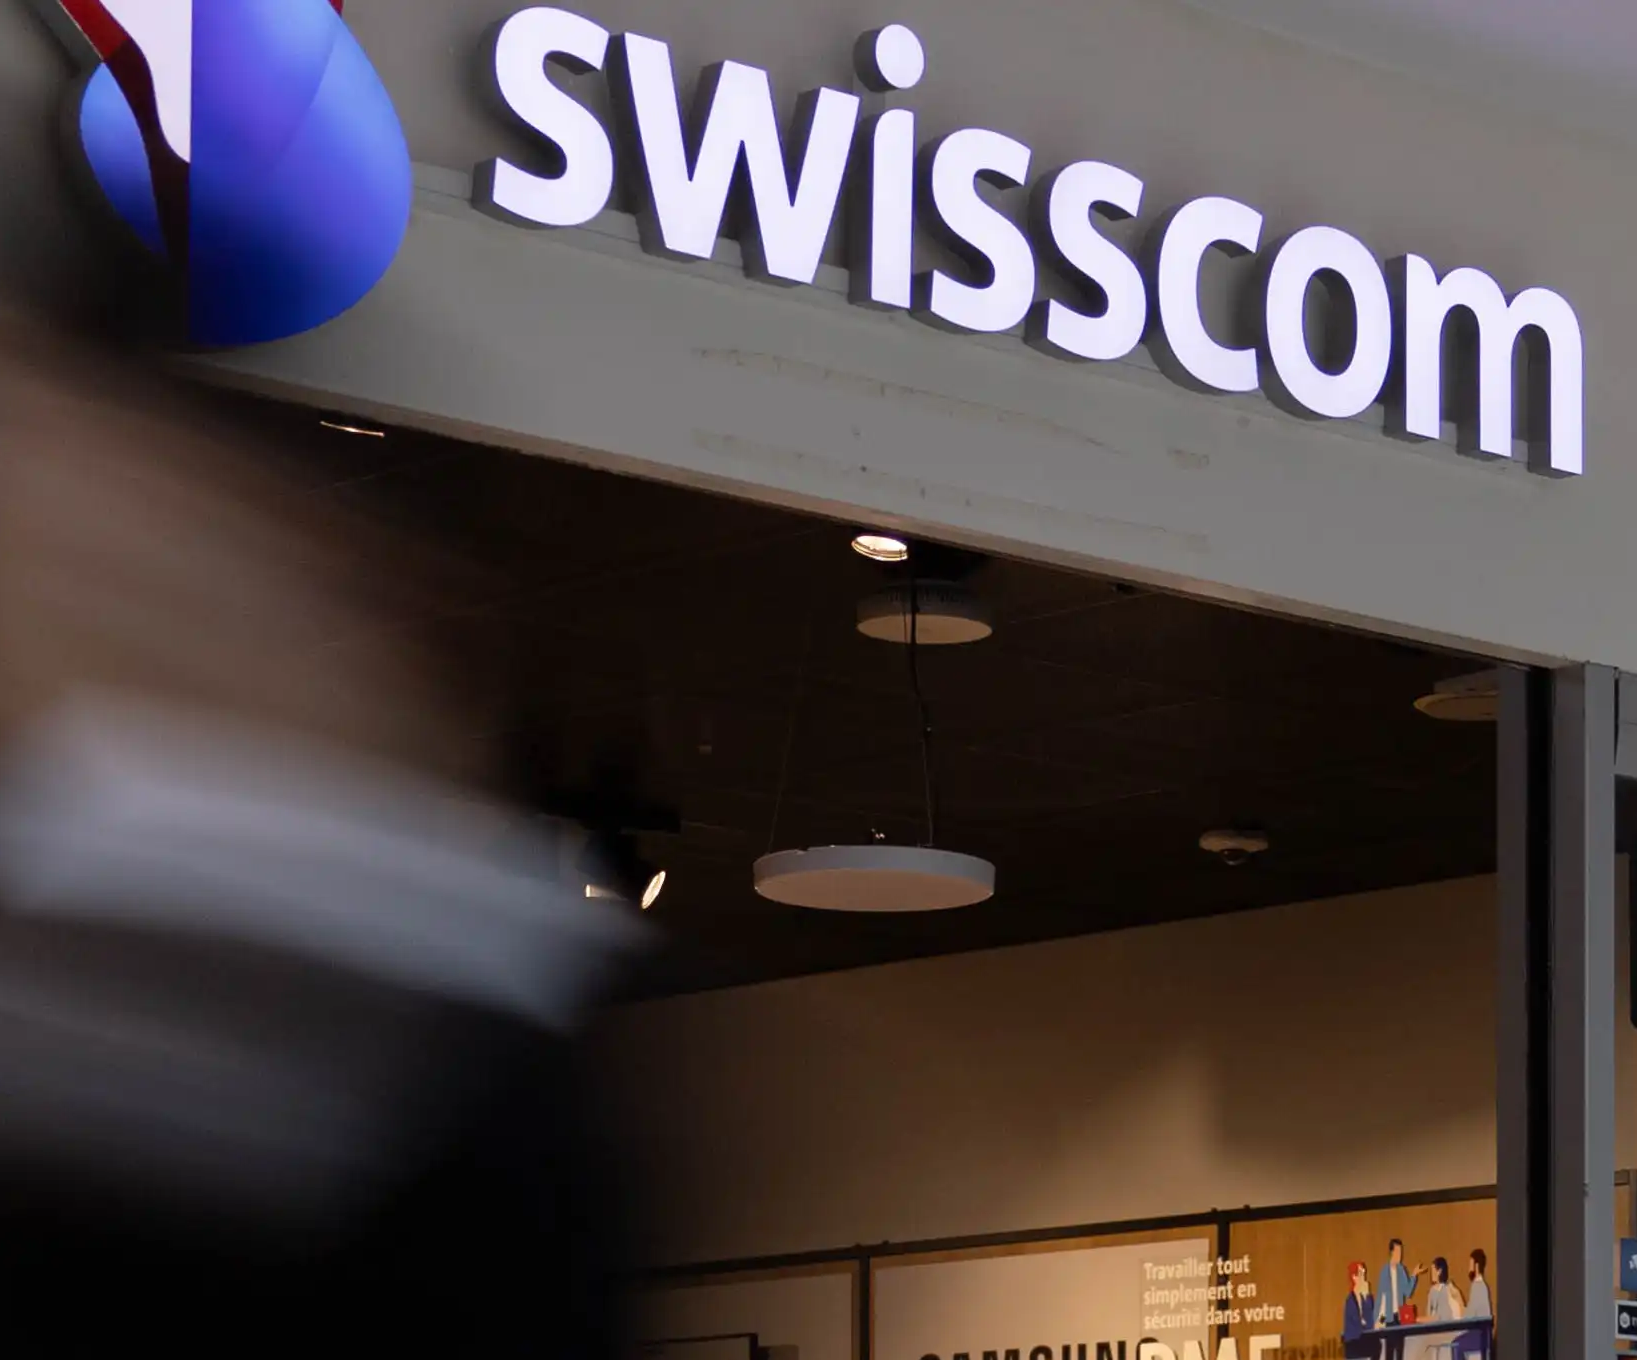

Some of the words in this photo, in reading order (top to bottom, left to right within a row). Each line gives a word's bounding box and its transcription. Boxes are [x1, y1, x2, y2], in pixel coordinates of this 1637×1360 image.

[492, 6, 1582, 476] swisscom
[1143, 1256, 1213, 1281] Travailler
[1216, 1253, 1251, 1276] tout
[1143, 1280, 1234, 1310] simplement
[1236, 1282, 1257, 1299] en
[1143, 1307, 1203, 1331] sécurité
[1206, 1305, 1241, 1326] dans
[1243, 1303, 1285, 1323] votre
